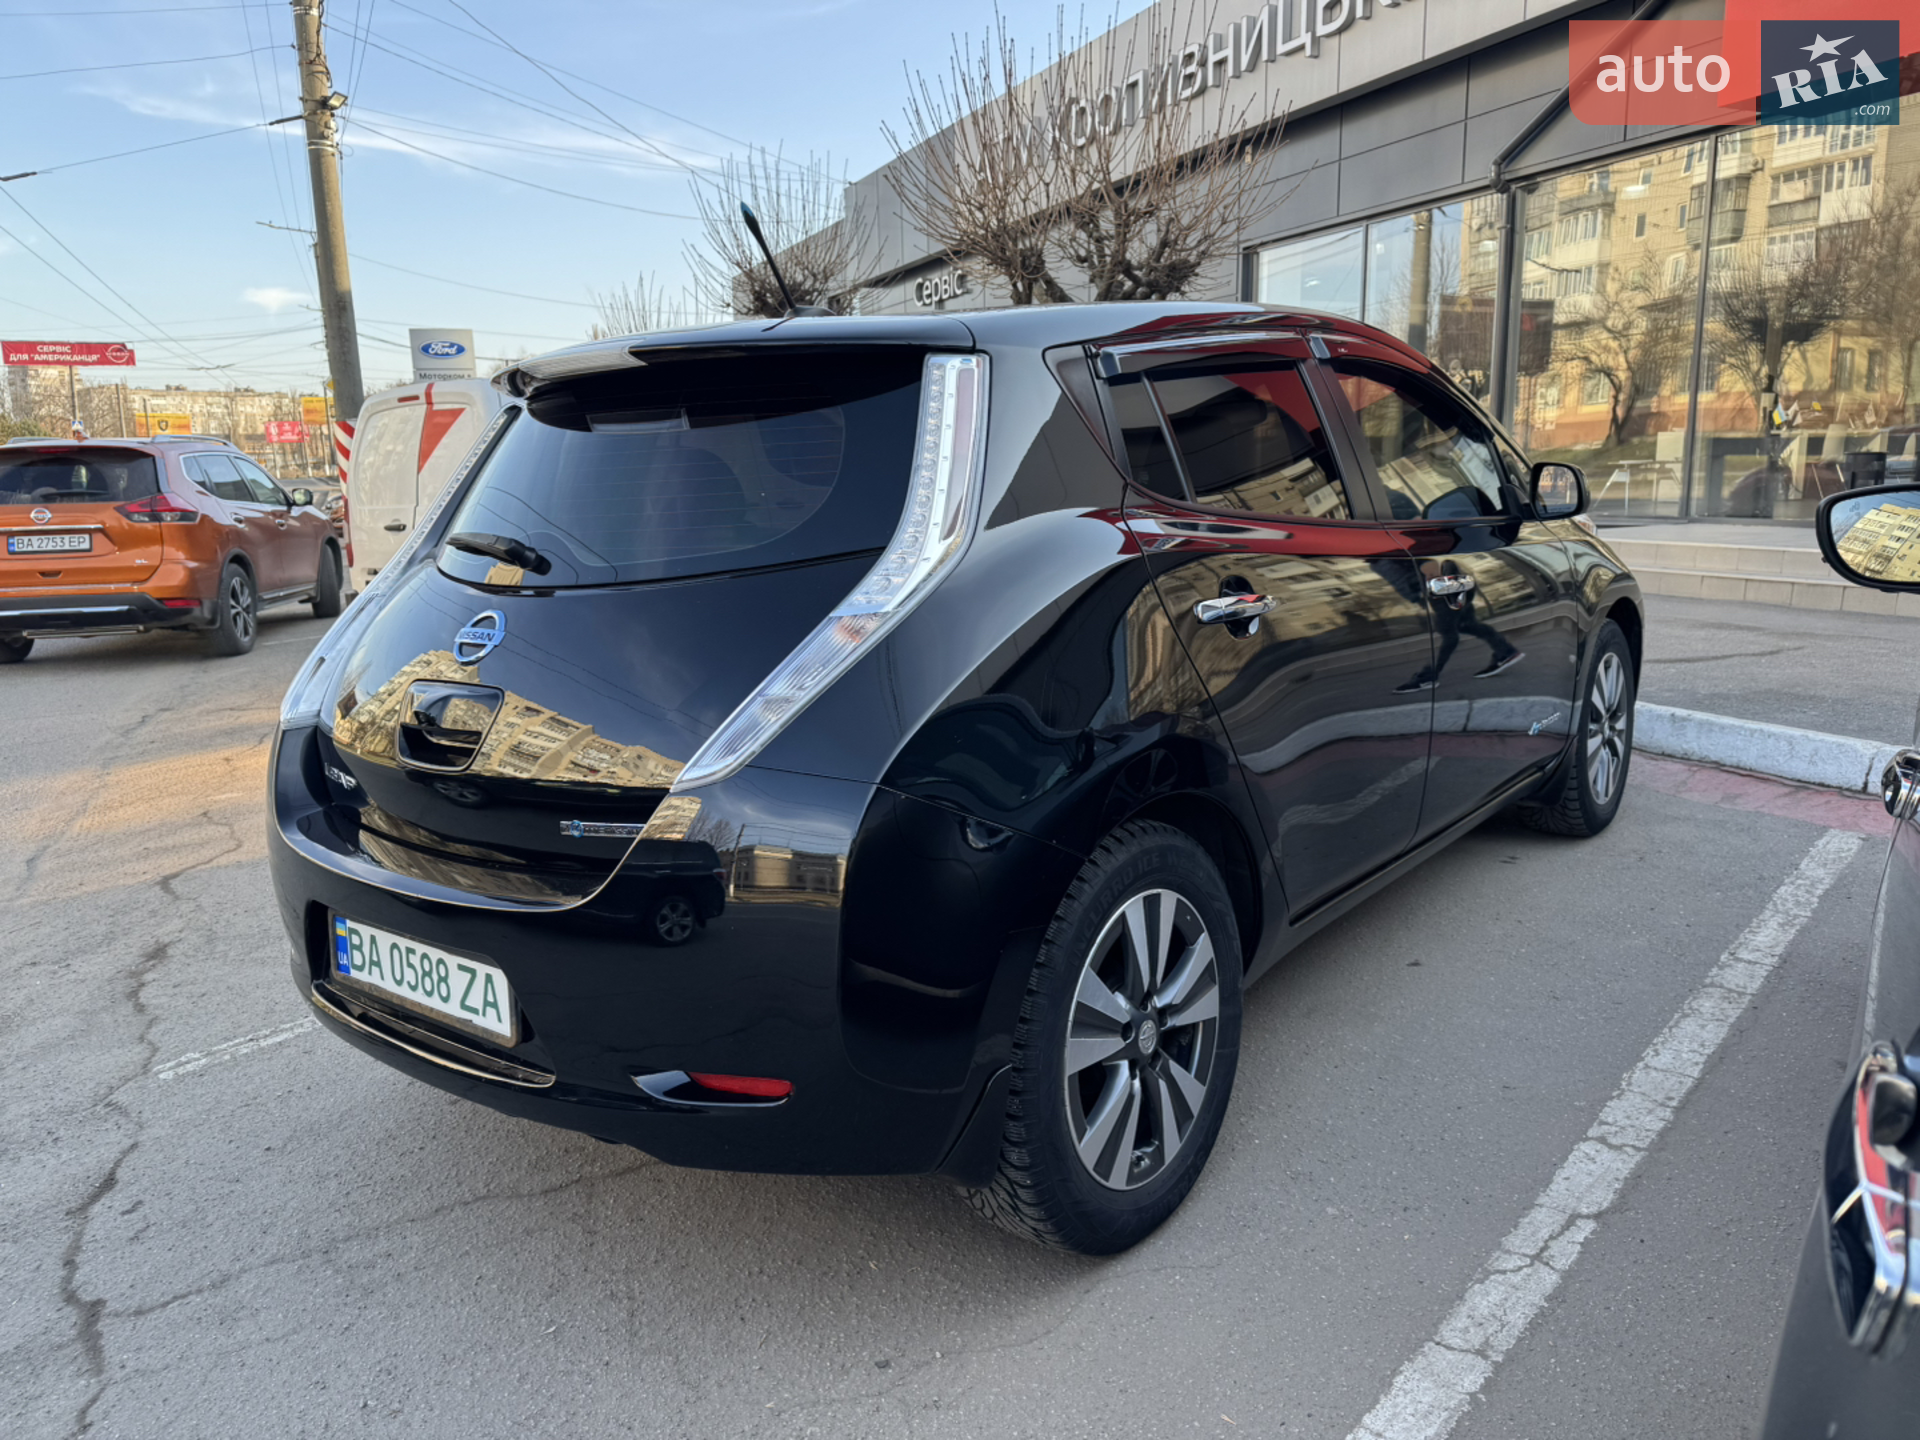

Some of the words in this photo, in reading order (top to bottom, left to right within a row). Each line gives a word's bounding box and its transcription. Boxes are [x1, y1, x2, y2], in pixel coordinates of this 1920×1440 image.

[913, 265, 963, 310] Сервіс
[36, 344, 72, 353] СЕРВІС
[428, 342, 458, 355] Ford
[9, 353, 29, 362] ДЛЯ
[16, 538, 34, 550] BA
[37, 536, 66, 549] 2753
[69, 535, 86, 548] EP
[337, 950, 348, 966] UA
[347, 926, 385, 982] BA
[389, 941, 451, 1004] 0588
[457, 962, 503, 1024] ZA
